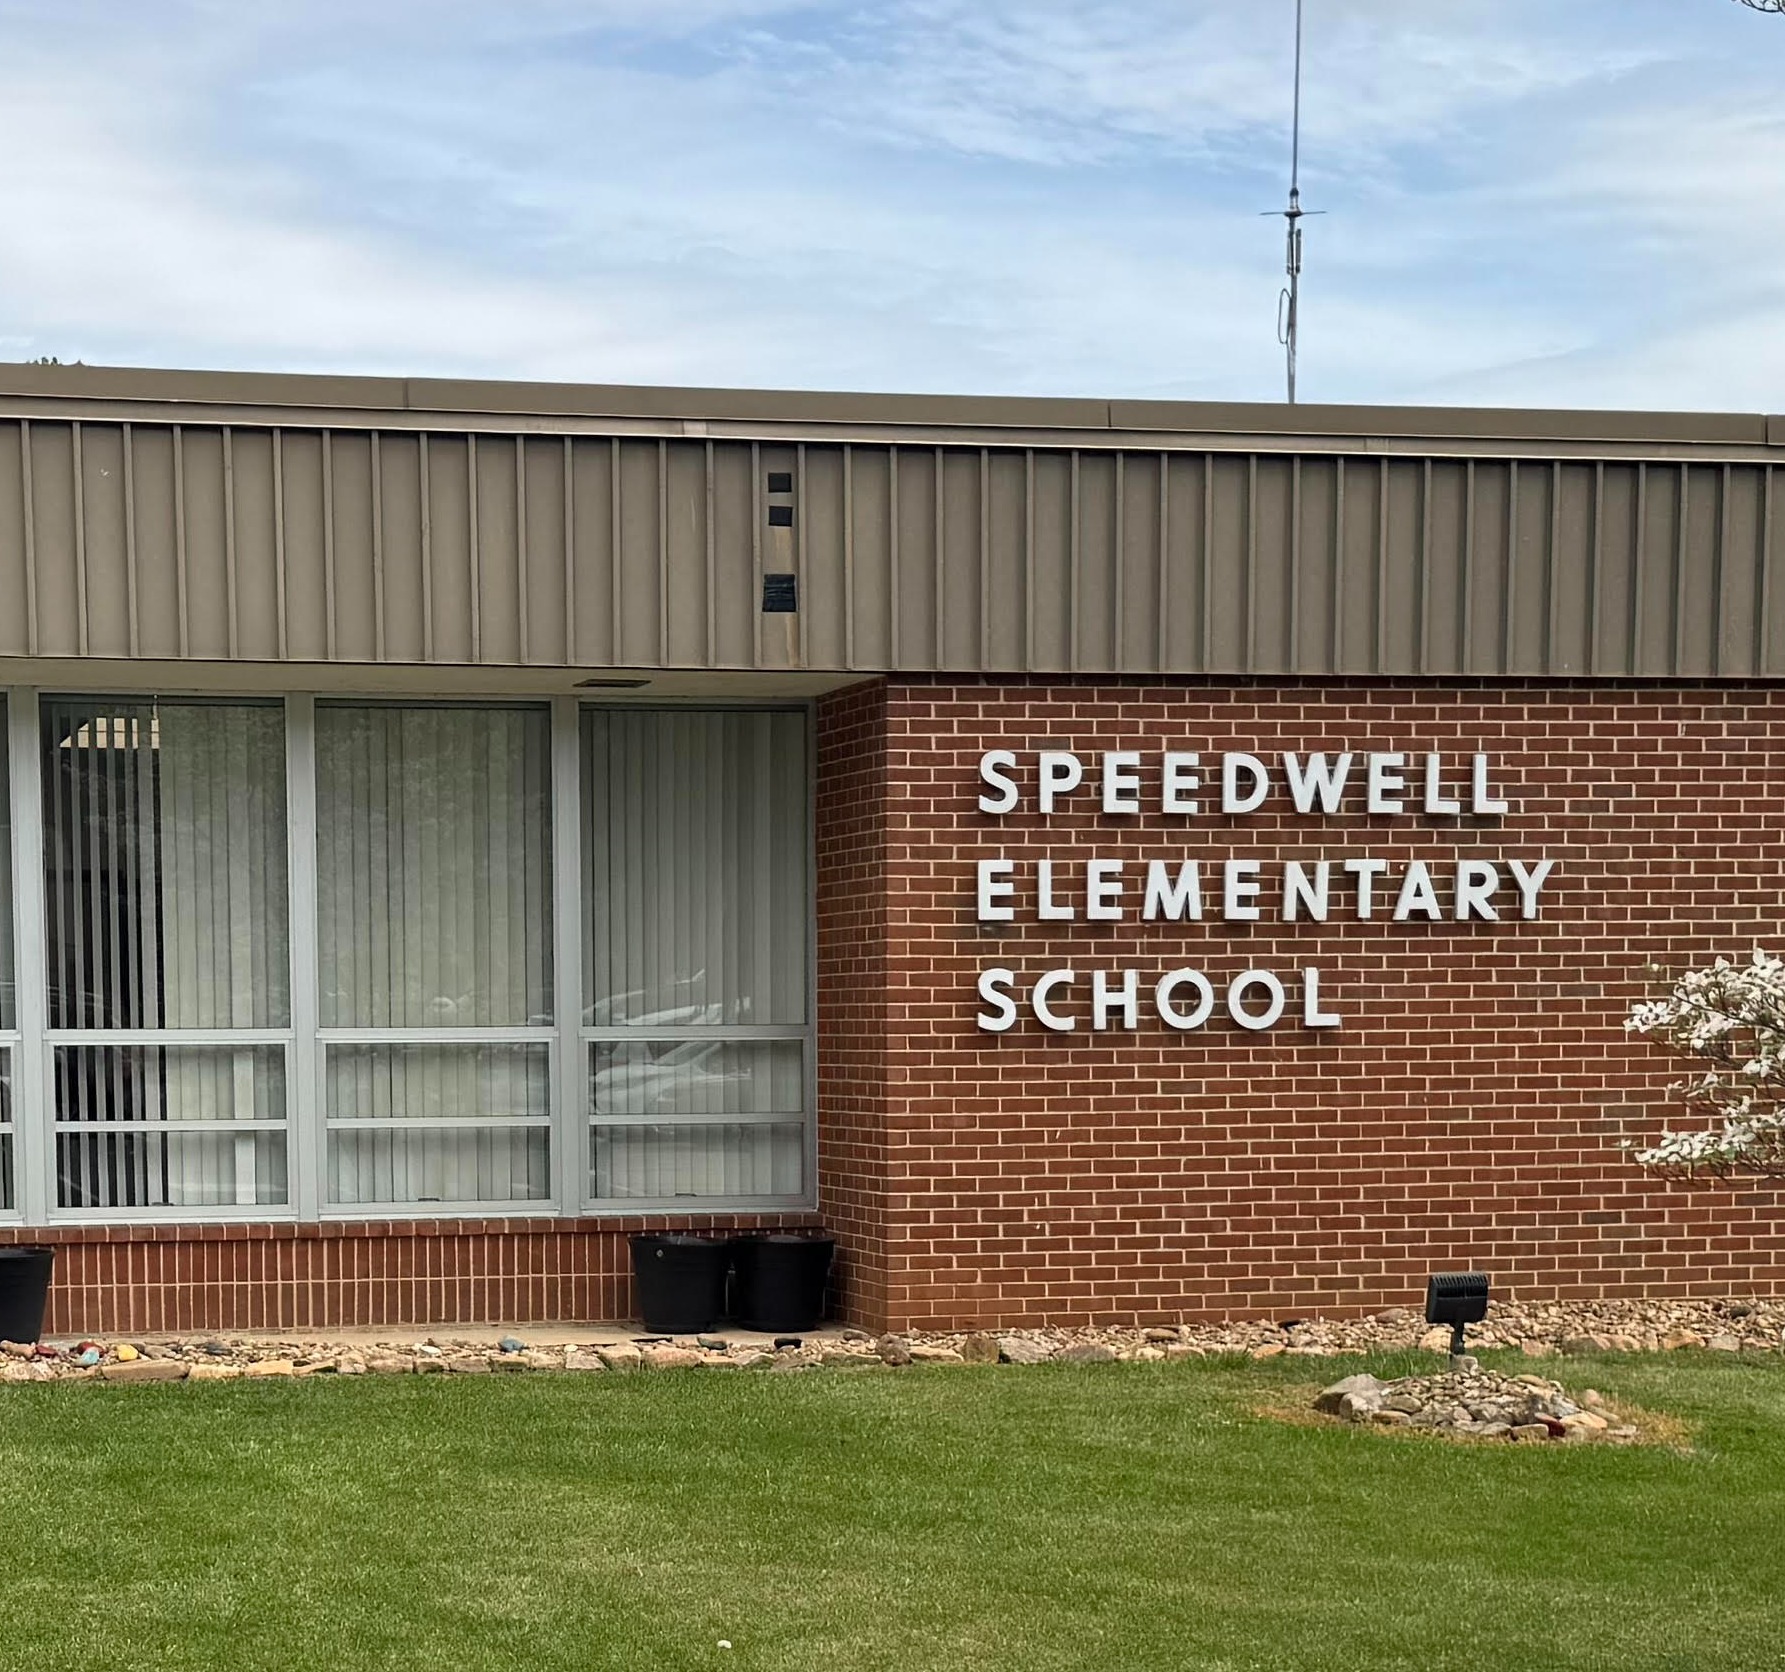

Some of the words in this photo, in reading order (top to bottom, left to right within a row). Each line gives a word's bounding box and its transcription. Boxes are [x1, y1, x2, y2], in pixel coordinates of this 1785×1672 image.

[978, 750, 1509, 814] SPEEDWELL
[977, 859, 1554, 921] ELEMENTARY
[977, 967, 1341, 1032] SCHOOL
